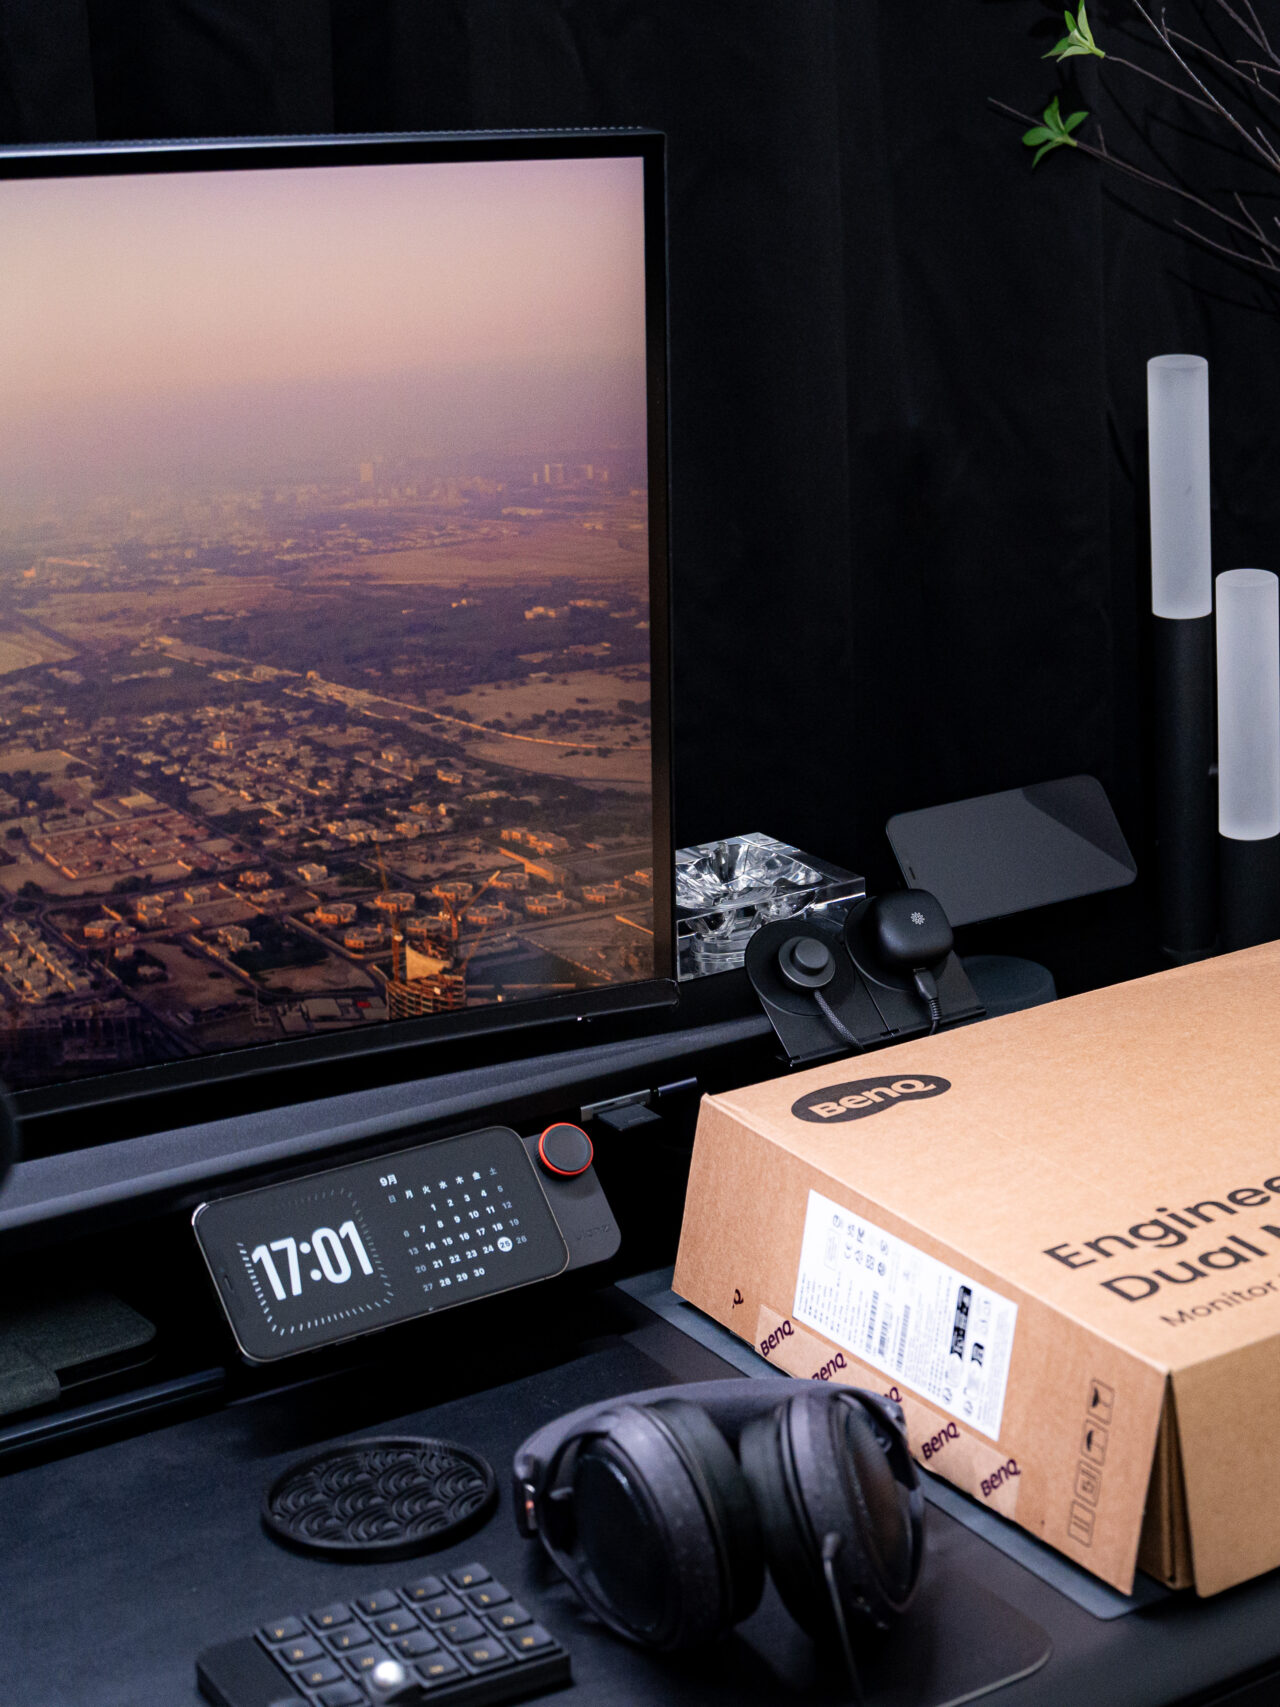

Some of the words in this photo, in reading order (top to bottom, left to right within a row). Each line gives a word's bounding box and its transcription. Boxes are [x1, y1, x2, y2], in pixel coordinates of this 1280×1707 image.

[807, 1079, 938, 1119] BenQ
[379, 1174, 398, 1187] 9月
[405, 1189, 414, 1199] 月
[430, 1203, 437, 1212] 1
[447, 1199, 455, 1207] 2
[463, 1194, 471, 1202] 3
[480, 1189, 488, 1198] 4
[497, 1185, 504, 1193] 5
[403, 1230, 410, 1238] 6
[419, 1225, 426, 1233] 7
[436, 1220, 444, 1229] 8
[453, 1215, 461, 1224] 9
[468, 1210, 480, 1220] 10
[485, 1205, 496, 1215] 11
[502, 1201, 513, 1209] 12
[408, 1247, 420, 1256] 13
[425, 1241, 437, 1251] 14
[441, 1236, 454, 1246] 15
[459, 1232, 470, 1242] 16
[475, 1227, 486, 1237] 17
[492, 1222, 504, 1232] 18
[509, 1218, 520, 1227] 19
[251, 1219, 374, 1301] 17:01
[415, 1264, 427, 1274] 20
[432, 1259, 444, 1269] 21
[449, 1254, 462, 1264] 22
[465, 1249, 478, 1260] 23
[482, 1244, 495, 1254] 24
[500, 1240, 511, 1249] 25
[516, 1235, 528, 1245] 26
[1100, 1235, 1268, 1303] Dual
[422, 1282, 433, 1292] 27
[439, 1277, 452, 1287] 28
[456, 1272, 469, 1283] 29
[473, 1267, 486, 1278] 30
[1159, 1280, 1279, 1327] Monitor
[760, 1320, 795, 1358] BenQ
[921, 1422, 961, 1461] BenQ
[980, 1458, 1022, 1498] BenQ
